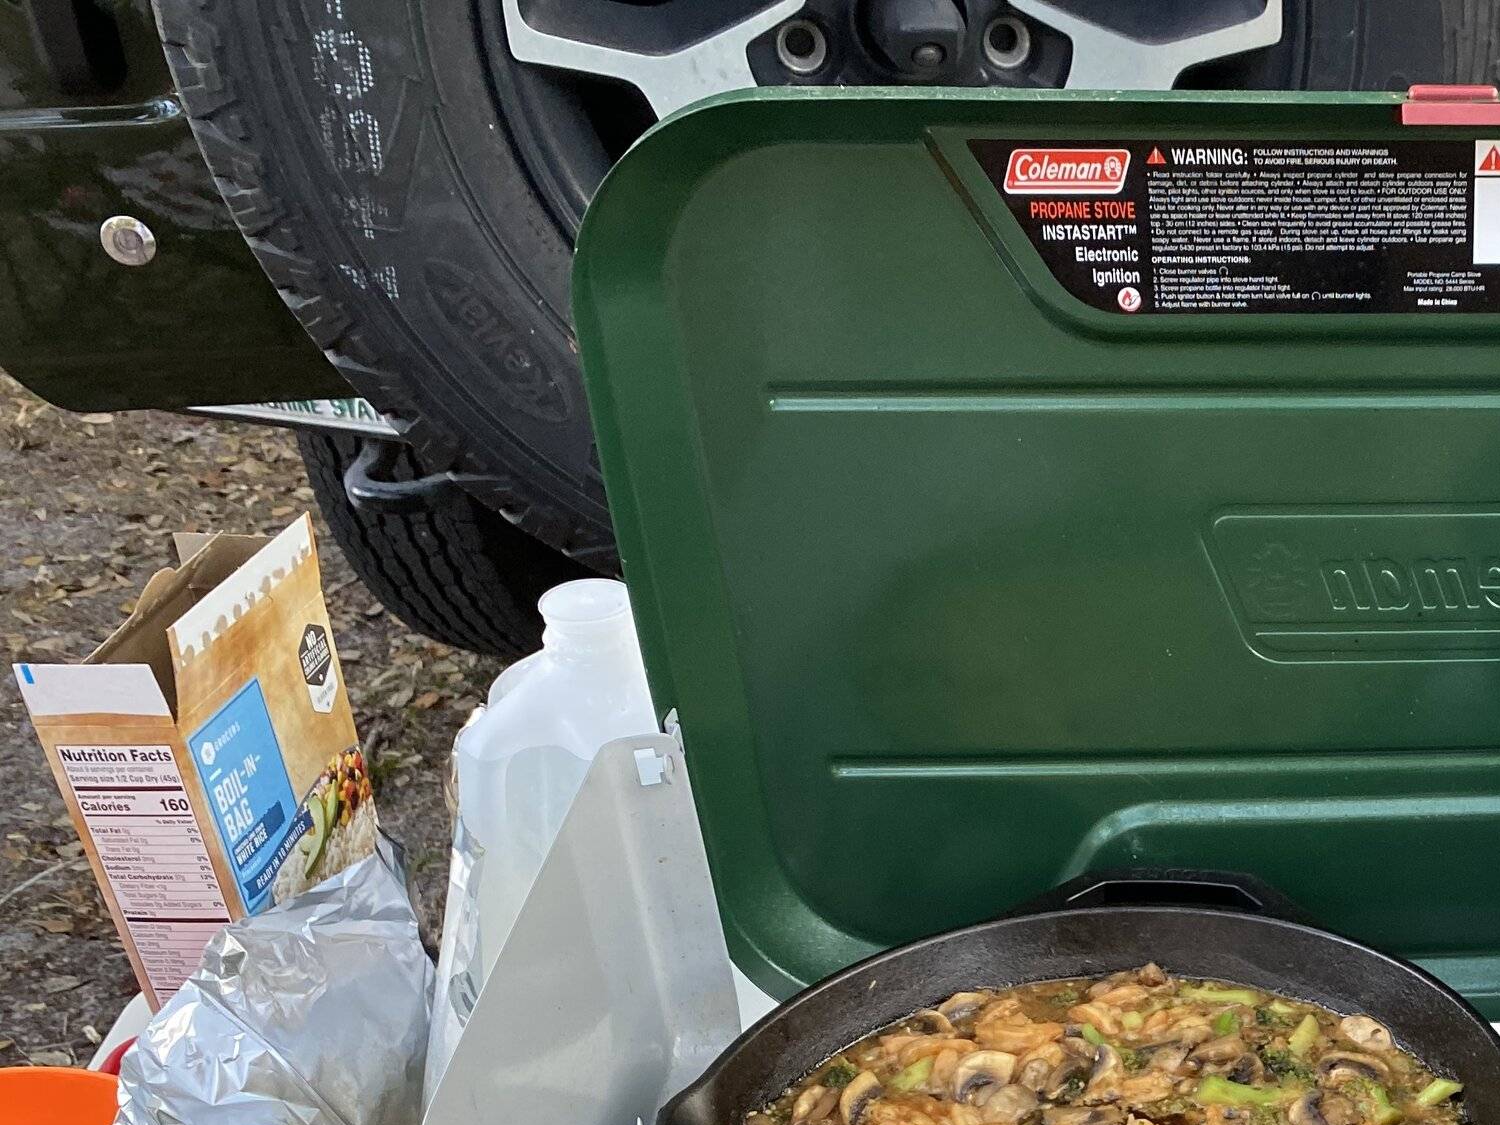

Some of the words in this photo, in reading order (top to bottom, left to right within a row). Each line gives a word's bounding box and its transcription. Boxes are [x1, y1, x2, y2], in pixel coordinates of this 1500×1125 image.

[1171, 148, 1249, 165] WARNING:
[1015, 154, 1102, 181] Coleman
[1030, 202, 1092, 219] PROPANE
[1094, 202, 1136, 219] STOVE
[1075, 246, 1139, 262] Electronic
[1151, 256, 1194, 264] OPERATING
[1092, 268, 1140, 286] Ignition
[1417, 298, 1433, 306] Made
[1441, 298, 1458, 306] China
[60, 749, 127, 762] Nutrition
[131, 749, 172, 762] Facts
[70, 774, 99, 784] Serving
[129, 775, 144, 784] Cup
[145, 775, 159, 784] Dry
[81, 801, 131, 812] Calories
[160, 799, 189, 812] 160
[224, 797, 254, 843] BAG
[256, 865, 275, 890] READY
[284, 820, 306, 852] MINUTES
